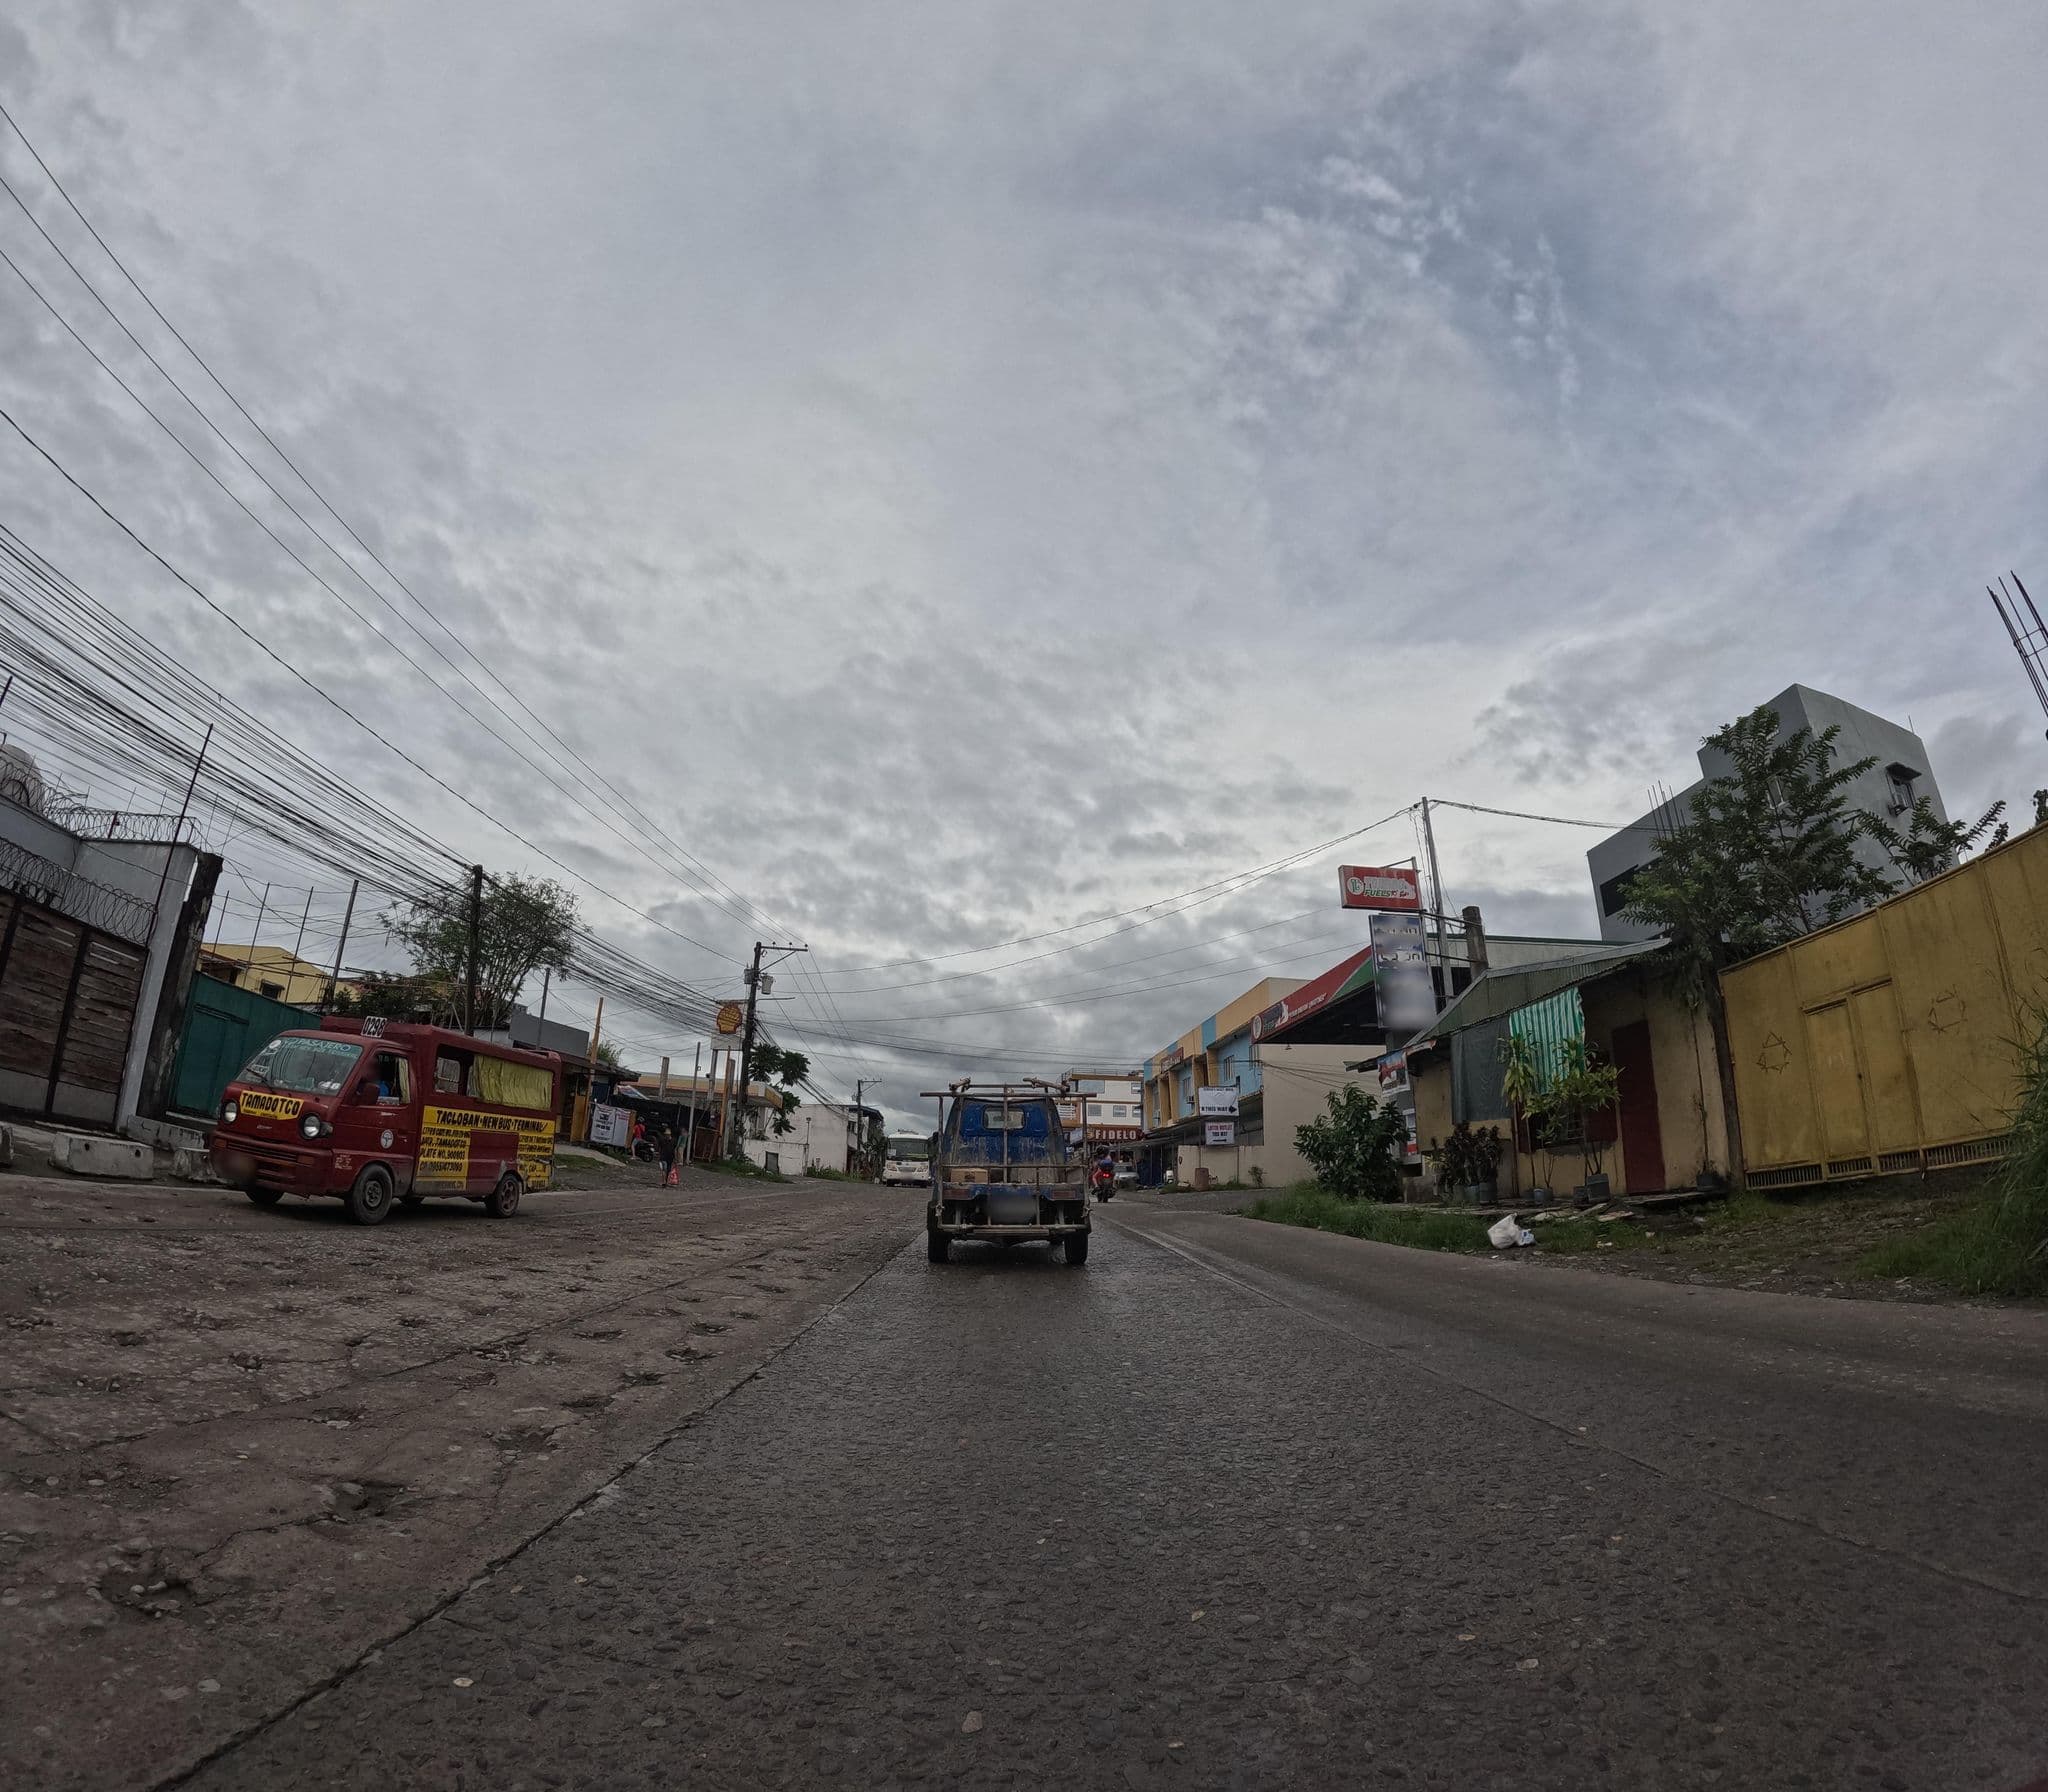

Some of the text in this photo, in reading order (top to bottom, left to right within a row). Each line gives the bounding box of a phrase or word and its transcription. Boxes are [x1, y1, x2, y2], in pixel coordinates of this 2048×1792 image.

[363, 1017, 386, 1036] 0298
[242, 1093, 301, 1116] TAMADOTCO
[1095, 1130, 1137, 1140] FIDELO
